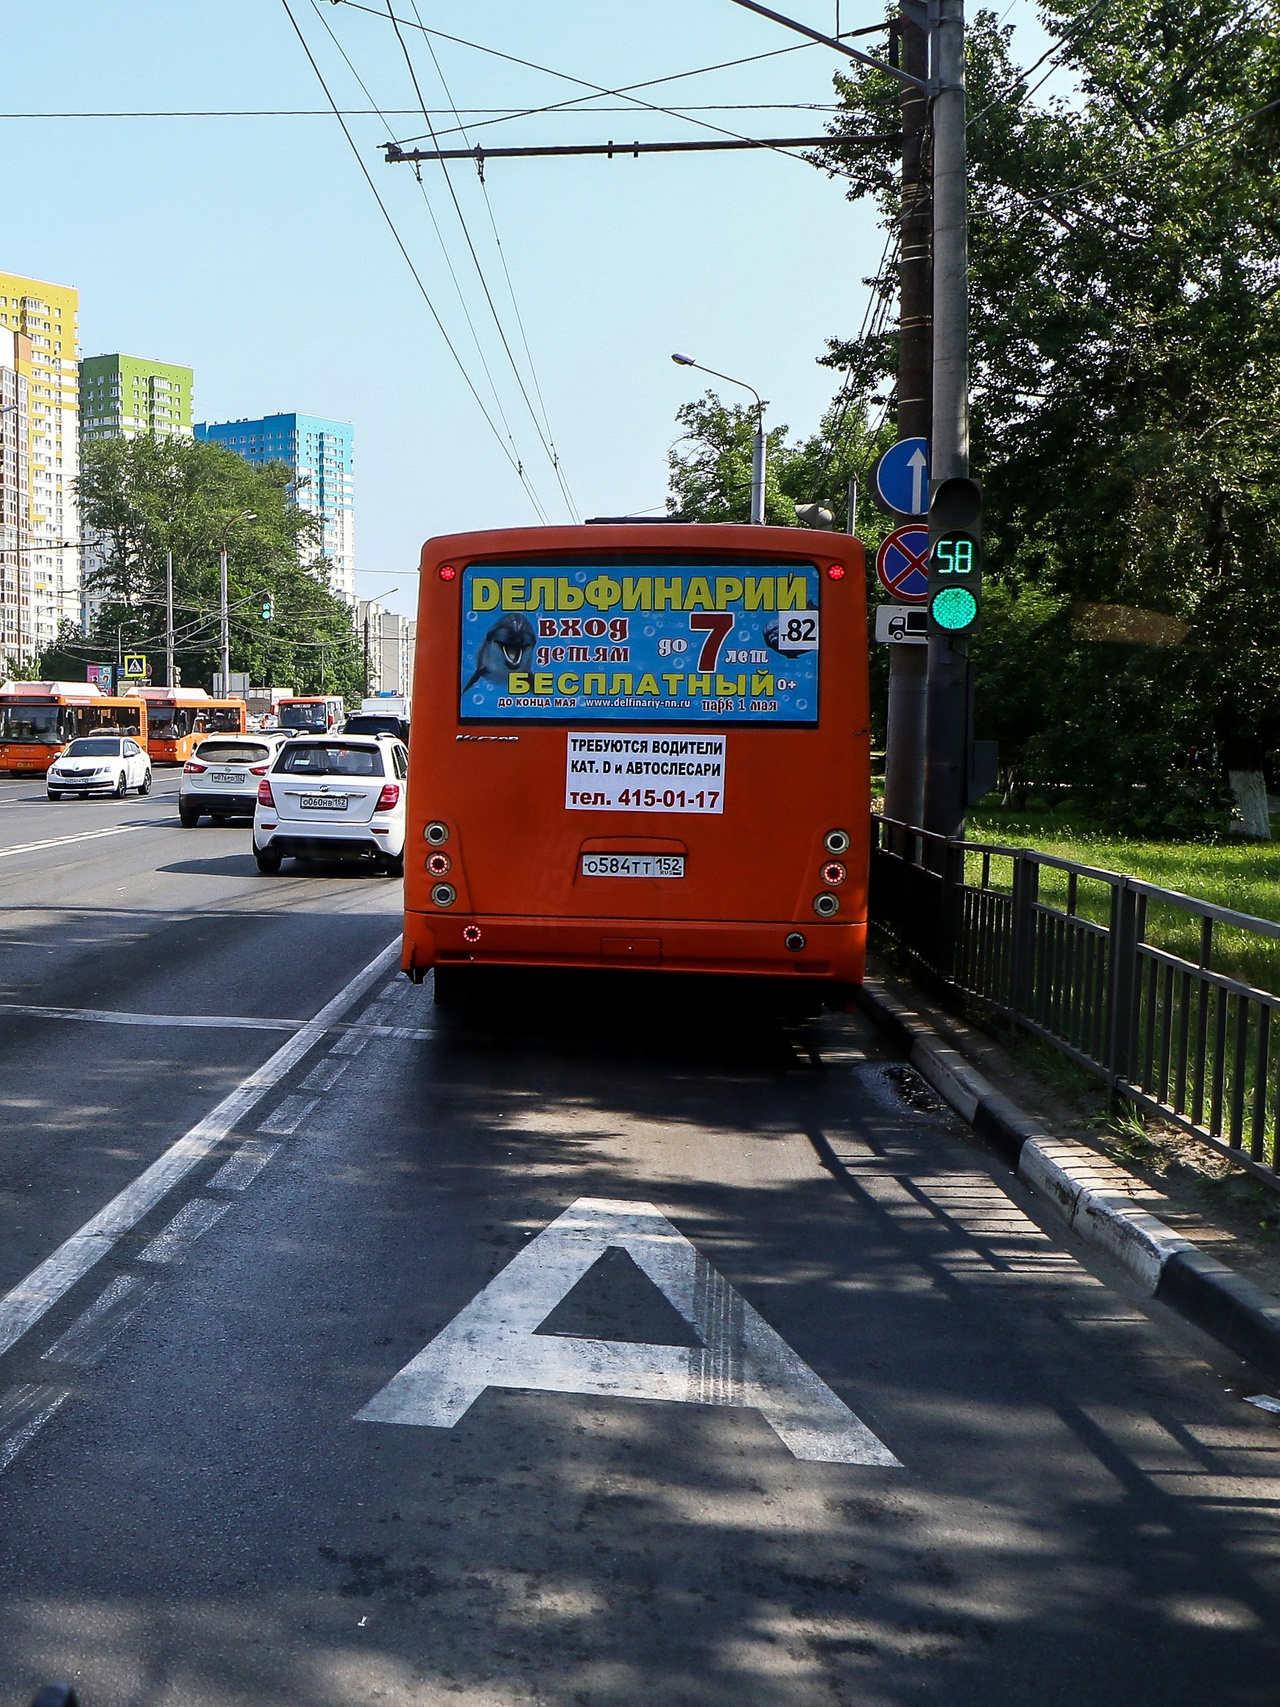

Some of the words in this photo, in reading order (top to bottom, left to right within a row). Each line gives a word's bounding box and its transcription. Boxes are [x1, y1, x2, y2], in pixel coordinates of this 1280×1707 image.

[936, 540, 973, 574] 58
[657, 638, 689, 657] до
[690, 612, 736, 673] 7
[725, 650, 769, 664] лет
[508, 669, 775, 696] БЕСПЛАТНЫЙ
[777, 678, 798, 692] 0+
[498, 698, 512, 708] ДО
[515, 697, 552, 708] КОНЦА
[554, 698, 577, 708] МАЯ
[585, 697, 691, 710] www.delfinariy-nn.ru
[701, 699, 734, 714] парк
[739, 699, 746, 711] 1
[750, 700, 778, 712] мая
[571, 739, 648, 754] ТРЕБУЮТСЯ
[652, 741, 723, 756] ВОДИТЕЛИ
[571, 760, 599, 774] КАТ.
[603, 761, 612, 774] D
[615, 764, 622, 774] и
[626, 761, 721, 776] АВТОСЛЕСАРИ
[303, 797, 333, 807] О060НВ
[334, 797, 346, 806] 152
[570, 791, 611, 806] тел.
[618, 789, 720, 808] 415-01-17
[587, 857, 652, 875] О584ТТ
[655, 858, 680, 871] 152
[351, 1197, 905, 1468] А
